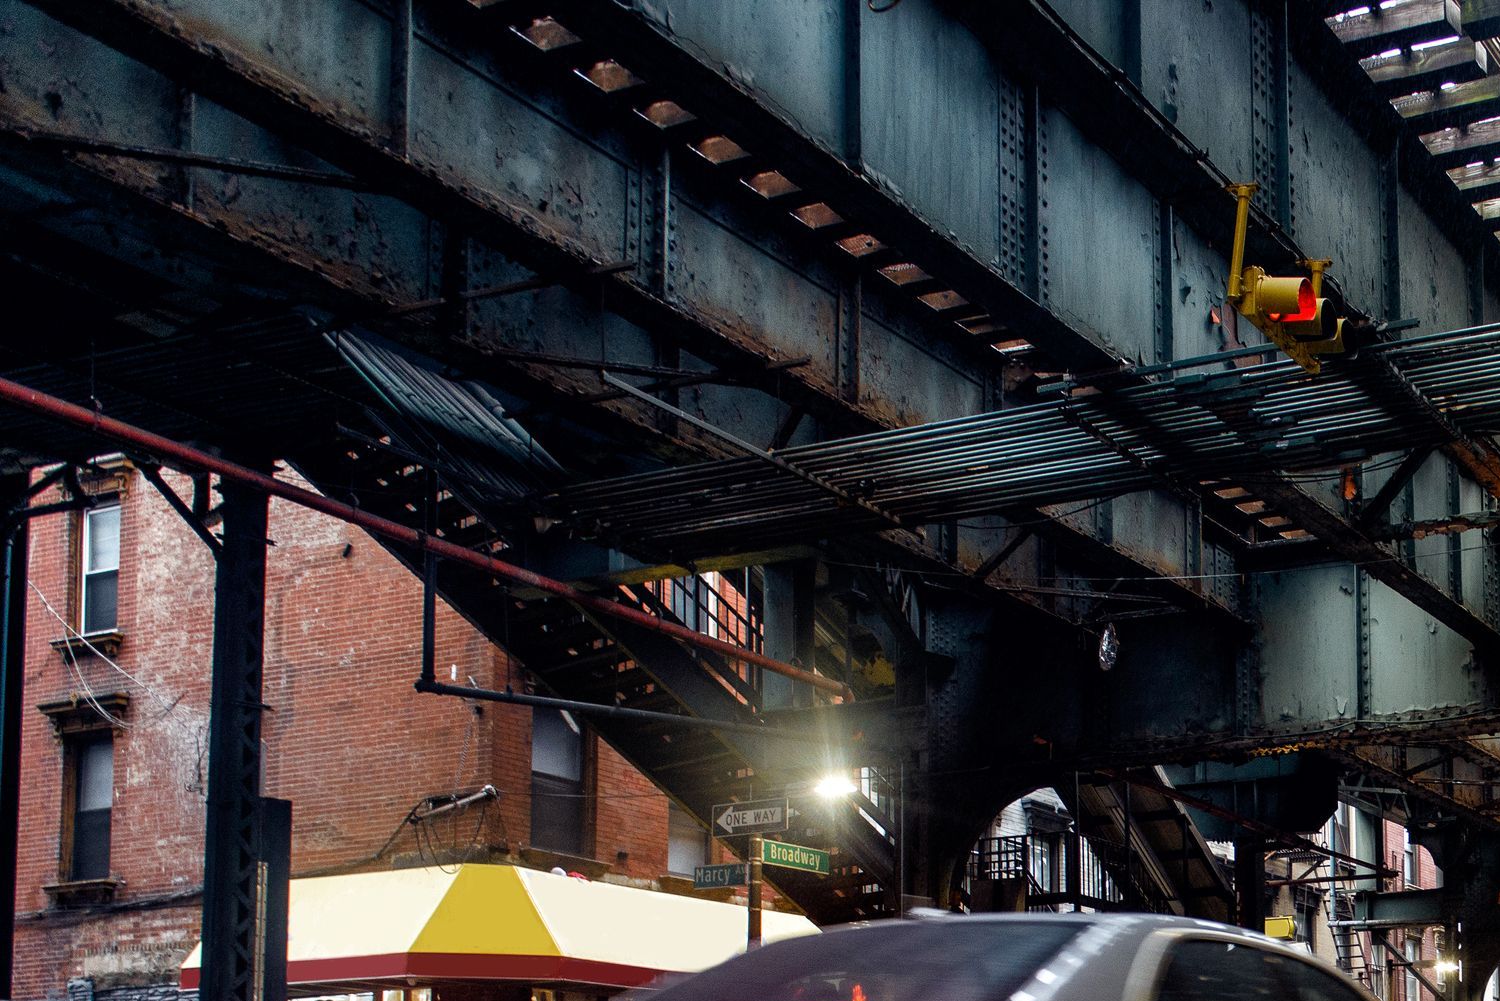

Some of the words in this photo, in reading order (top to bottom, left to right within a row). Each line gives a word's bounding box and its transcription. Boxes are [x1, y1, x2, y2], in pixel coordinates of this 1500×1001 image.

[726, 813, 747, 826] ONE
[753, 809, 776, 824] WAY
[771, 844, 820, 871] Broadway
[695, 868, 730, 886] Marcy
